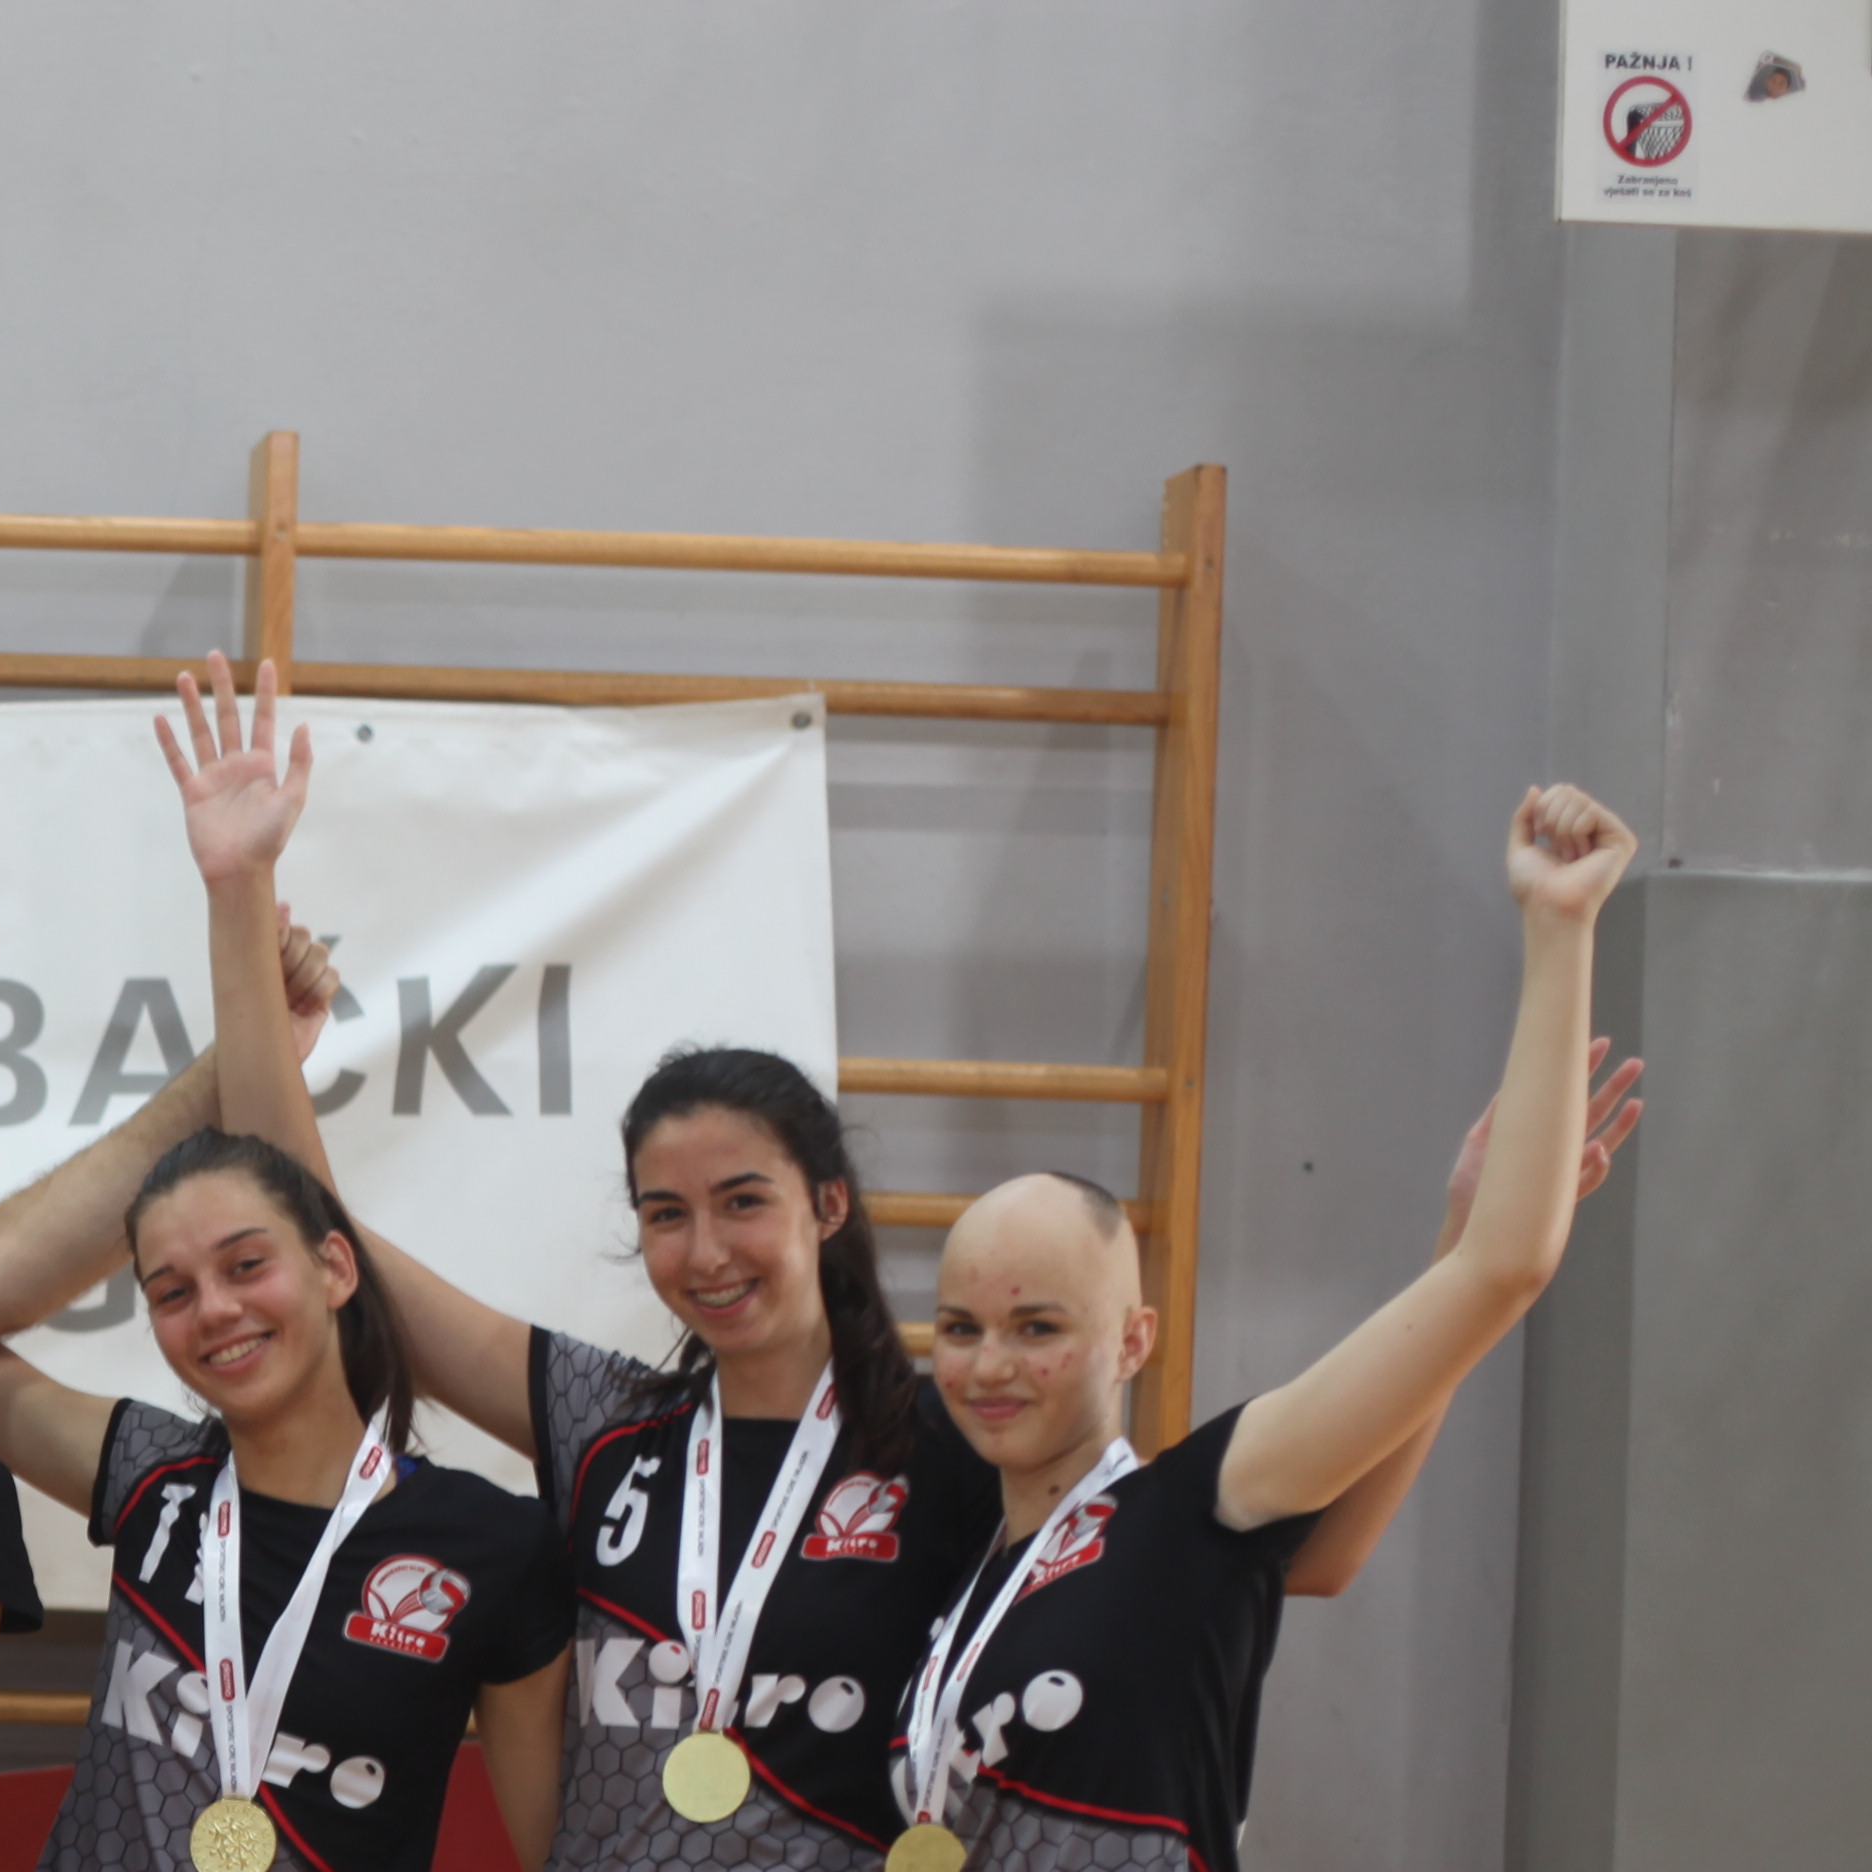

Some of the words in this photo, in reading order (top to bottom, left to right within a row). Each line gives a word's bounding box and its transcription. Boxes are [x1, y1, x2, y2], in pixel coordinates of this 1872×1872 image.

[1604, 52, 1681, 71] PAŽNJA
[596, 1455, 661, 1567] 5
[576, 1636, 866, 1734] Kiro
